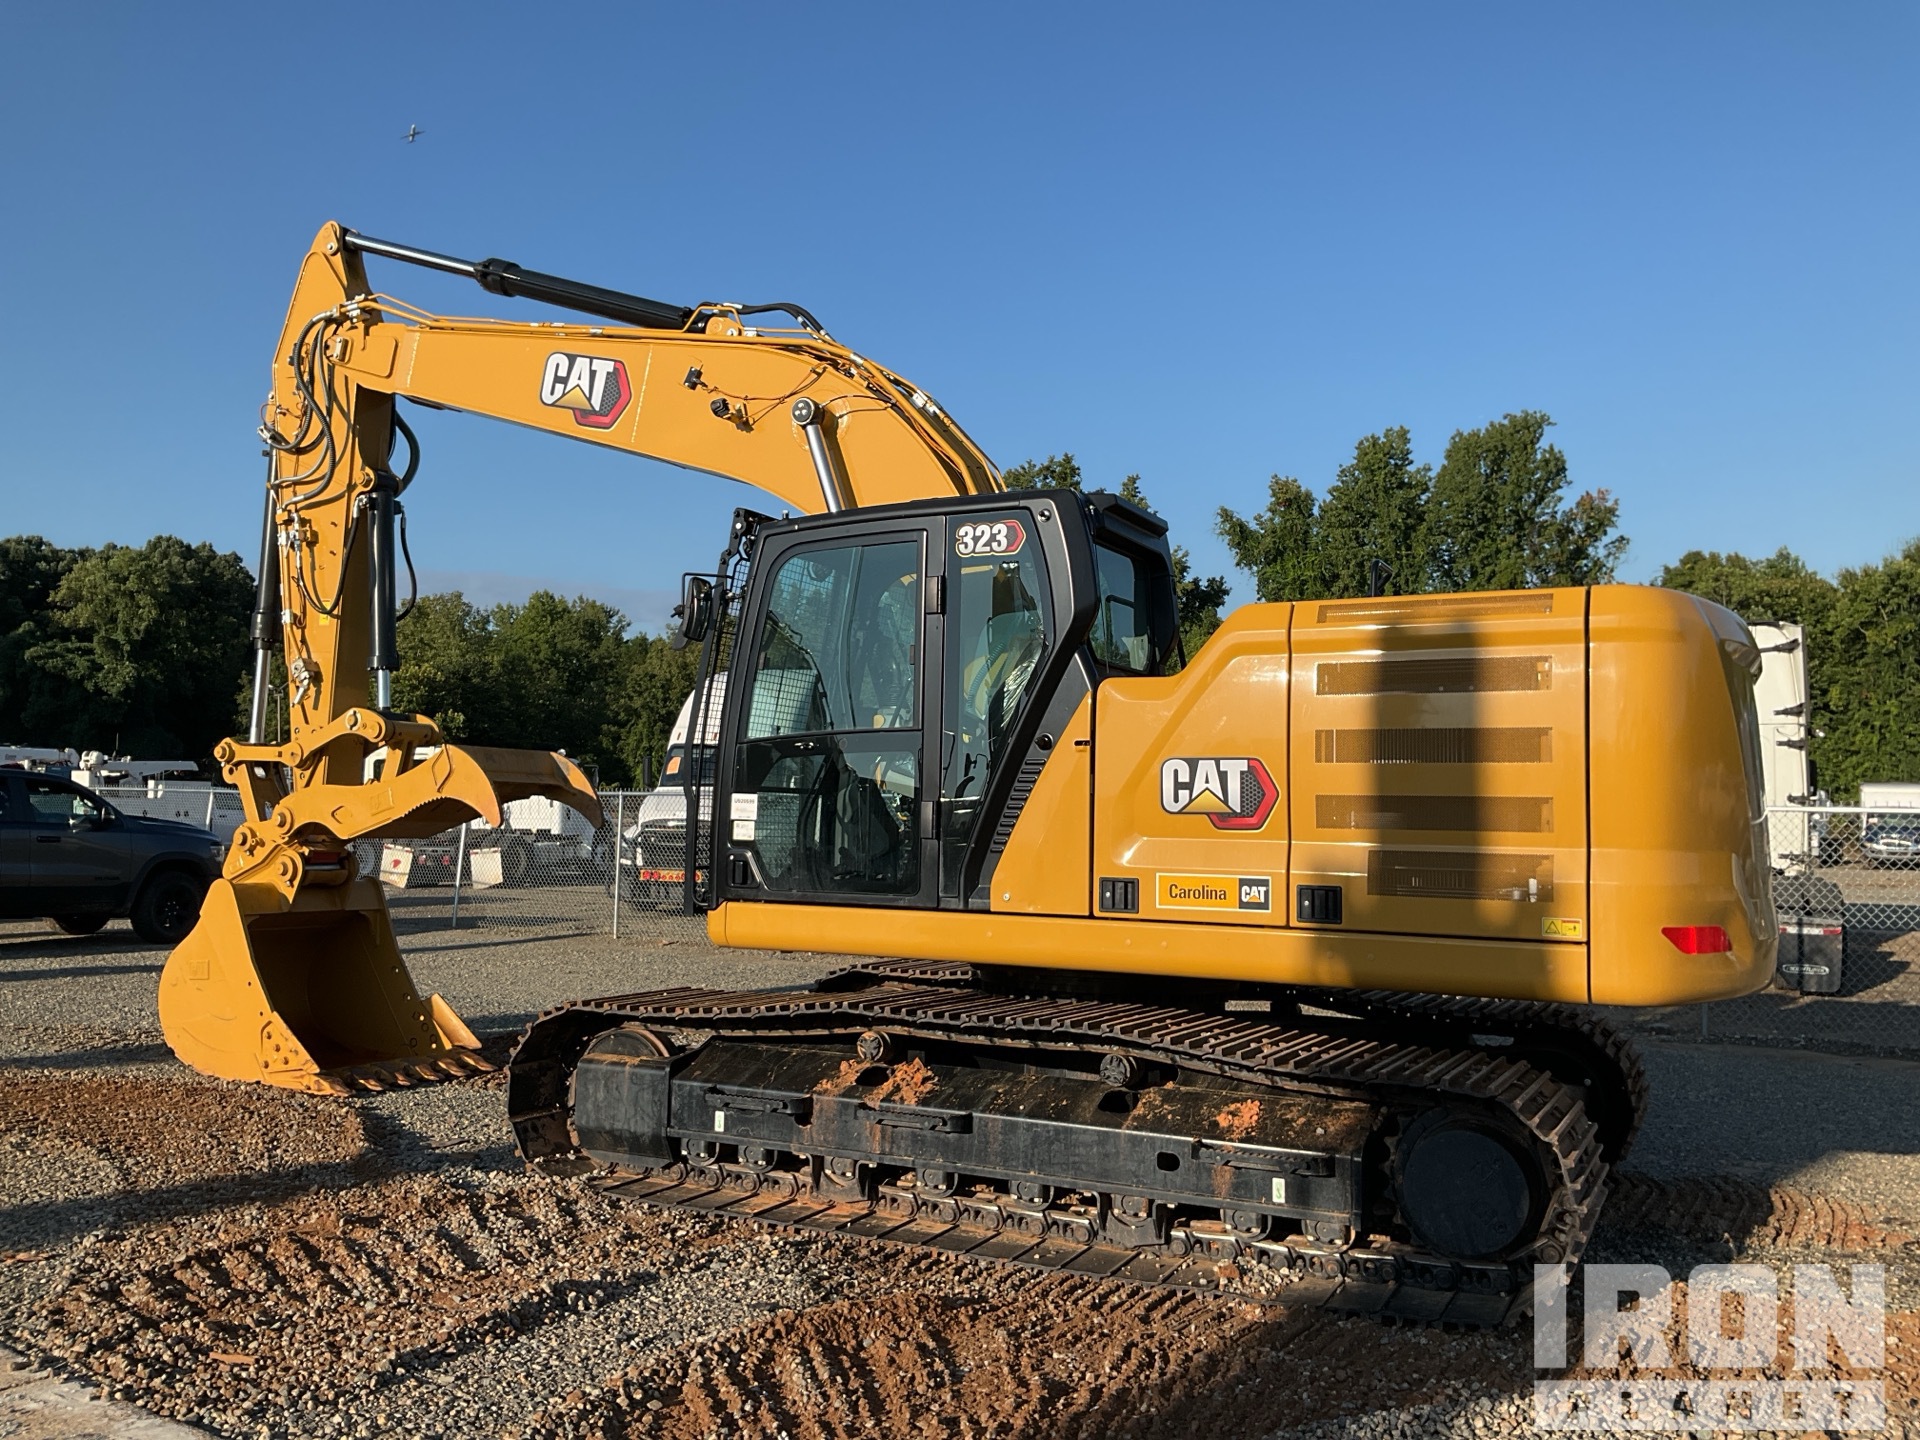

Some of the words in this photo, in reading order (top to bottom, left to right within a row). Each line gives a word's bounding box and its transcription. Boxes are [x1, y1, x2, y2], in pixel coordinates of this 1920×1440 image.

[541, 353, 615, 411] CAT
[958, 523, 1008, 554] 323
[1161, 758, 1249, 813] CAT
[1168, 883, 1227, 901] Carolina
[1240, 885, 1267, 903] CAT
